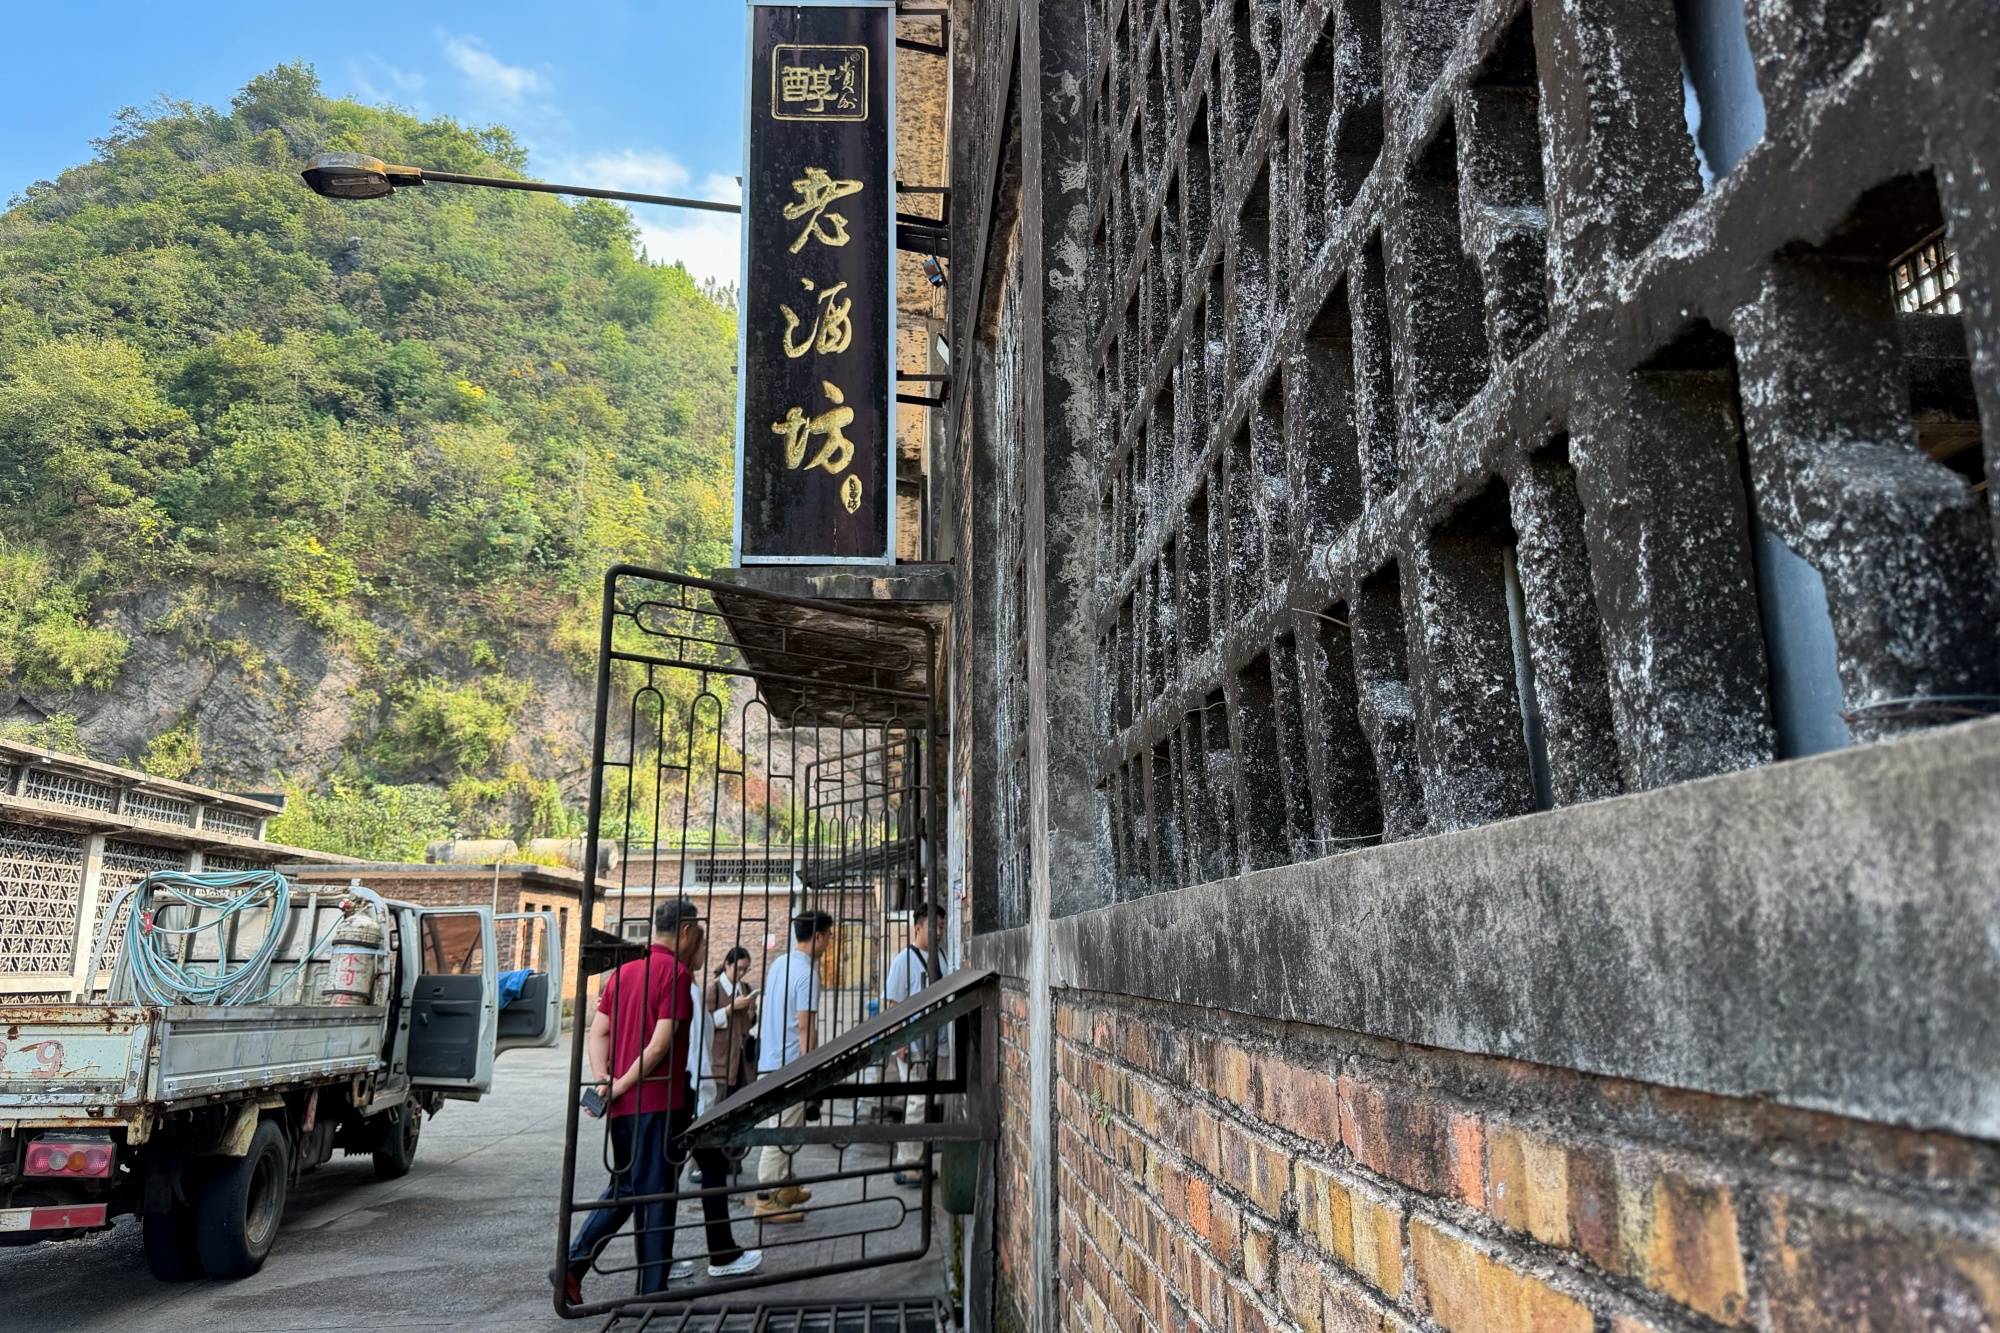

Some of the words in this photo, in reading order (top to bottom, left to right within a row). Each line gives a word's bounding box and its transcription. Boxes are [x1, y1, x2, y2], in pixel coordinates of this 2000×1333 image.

[781, 63, 839, 113] 醇
[770, 166, 864, 475] 老酒坊
